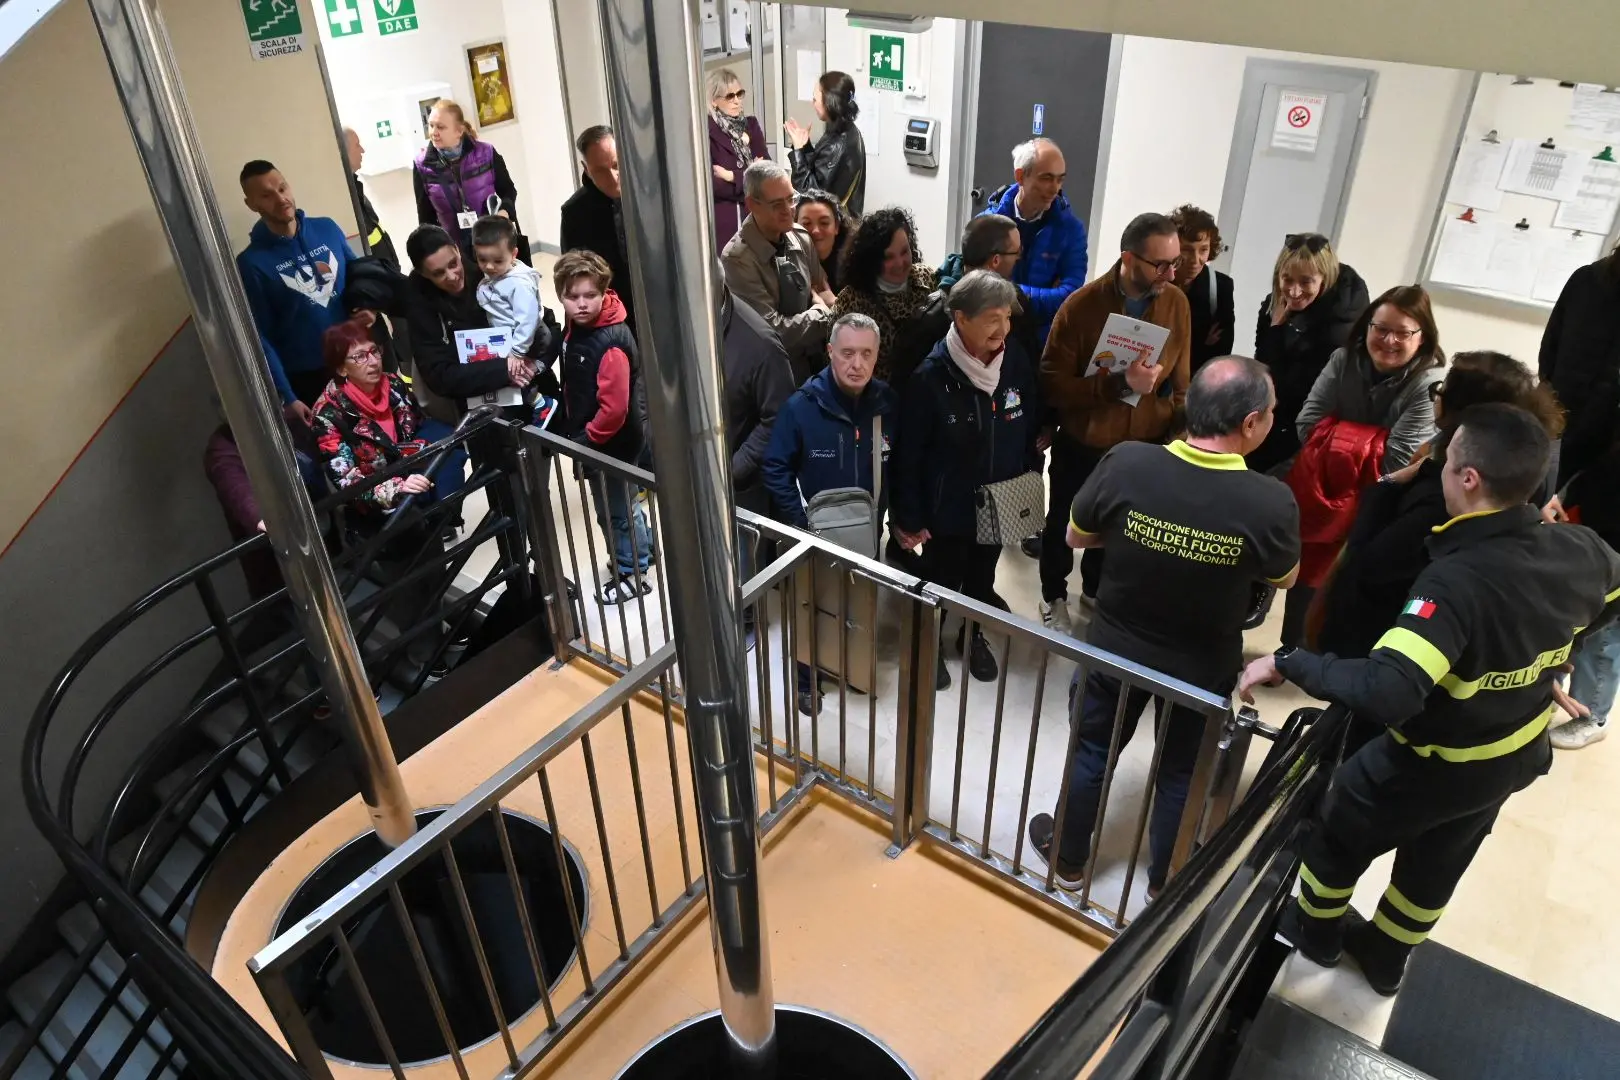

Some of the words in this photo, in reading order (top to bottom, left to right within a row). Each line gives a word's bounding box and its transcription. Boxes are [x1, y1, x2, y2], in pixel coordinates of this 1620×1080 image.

[385, 19, 412, 33] DAE
[259, 44, 302, 59] SICUREZZA
[260, 38, 288, 49] SCALA
[288, 36, 297, 45] DI
[1127, 509, 1191, 535] ASSOCIAZIONE
[1191, 528, 1244, 545] NAZIONALE
[1124, 528, 1140, 542] DEL
[1141, 537, 1176, 554] CORPO
[1177, 548, 1239, 565] NAZIONALE
[1126, 517, 1161, 541] VIGILI
[1163, 532, 1189, 548] DEL
[1190, 539, 1242, 557] FUOCO
[1477, 670, 1528, 689] VIGILI
